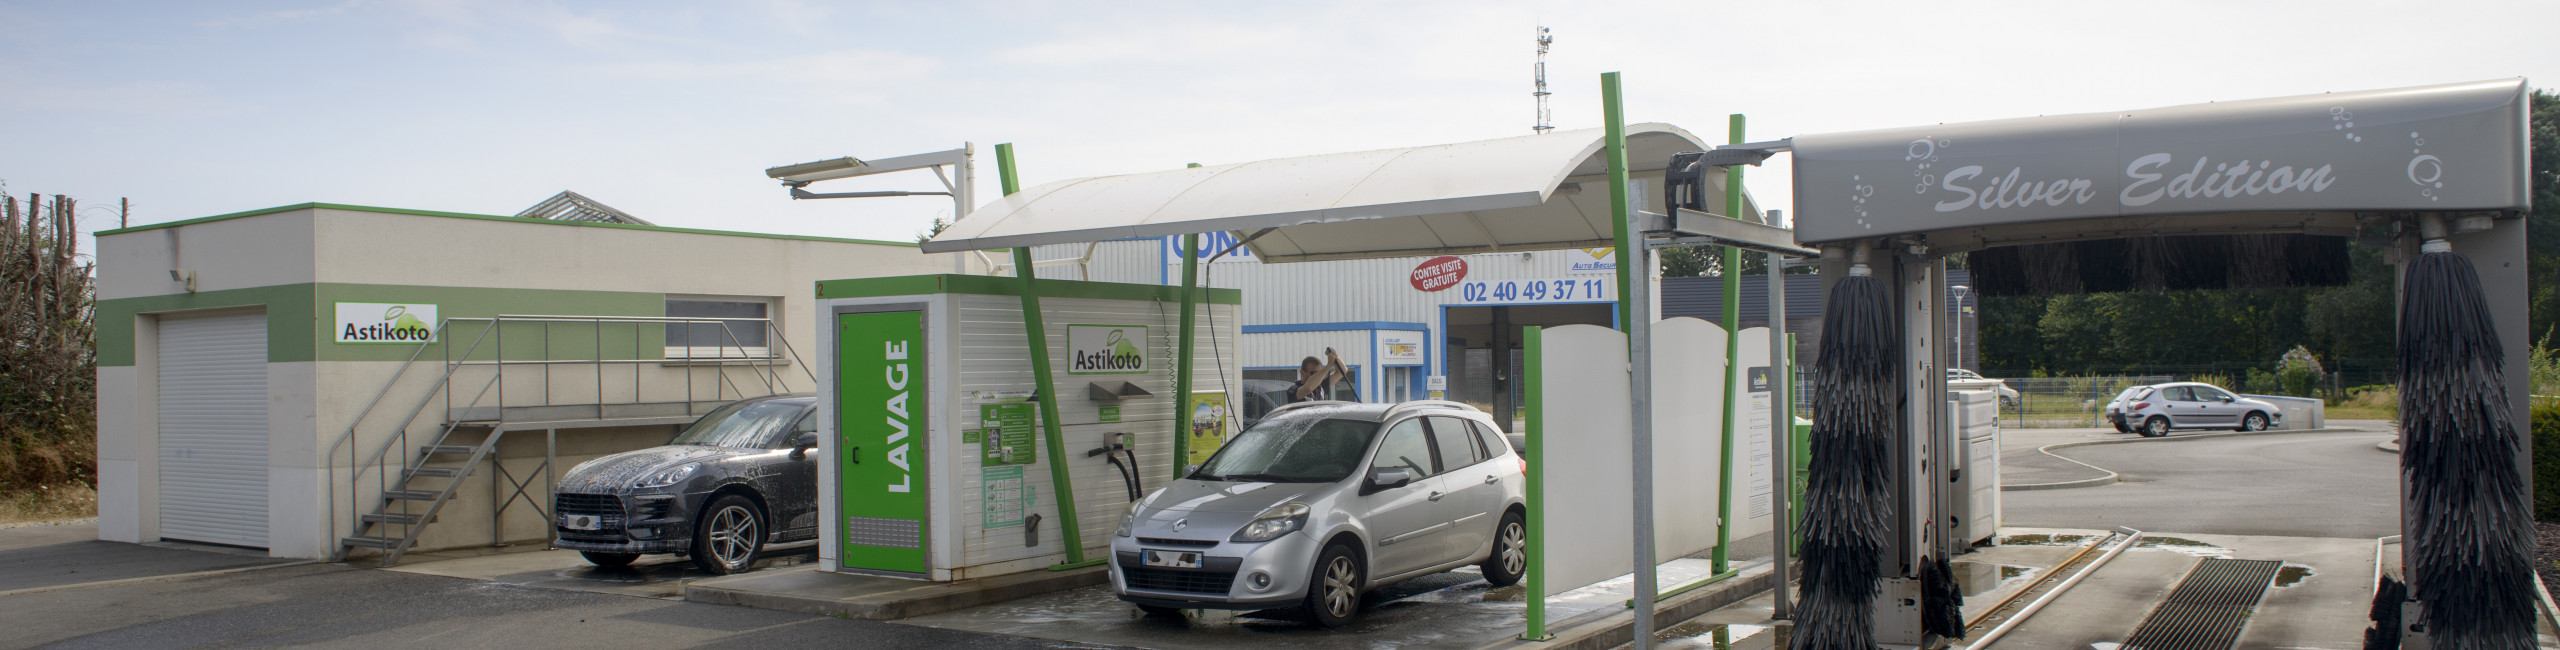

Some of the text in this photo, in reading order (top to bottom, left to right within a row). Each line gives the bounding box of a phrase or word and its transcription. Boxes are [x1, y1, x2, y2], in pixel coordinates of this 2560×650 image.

[1934, 153, 2336, 212] Silver Edition
[1414, 259, 1462, 281] CONTRE VISITE
[817, 283, 824, 297] 2
[936, 276, 941, 290] 1
[1422, 272, 1458, 290] GRATUITE
[1463, 279, 1603, 302] 02 40 49 37 11
[343, 322, 430, 341] Astikoto
[1075, 349, 1142, 370] Astikoto
[885, 340, 910, 492] LAVAGE
